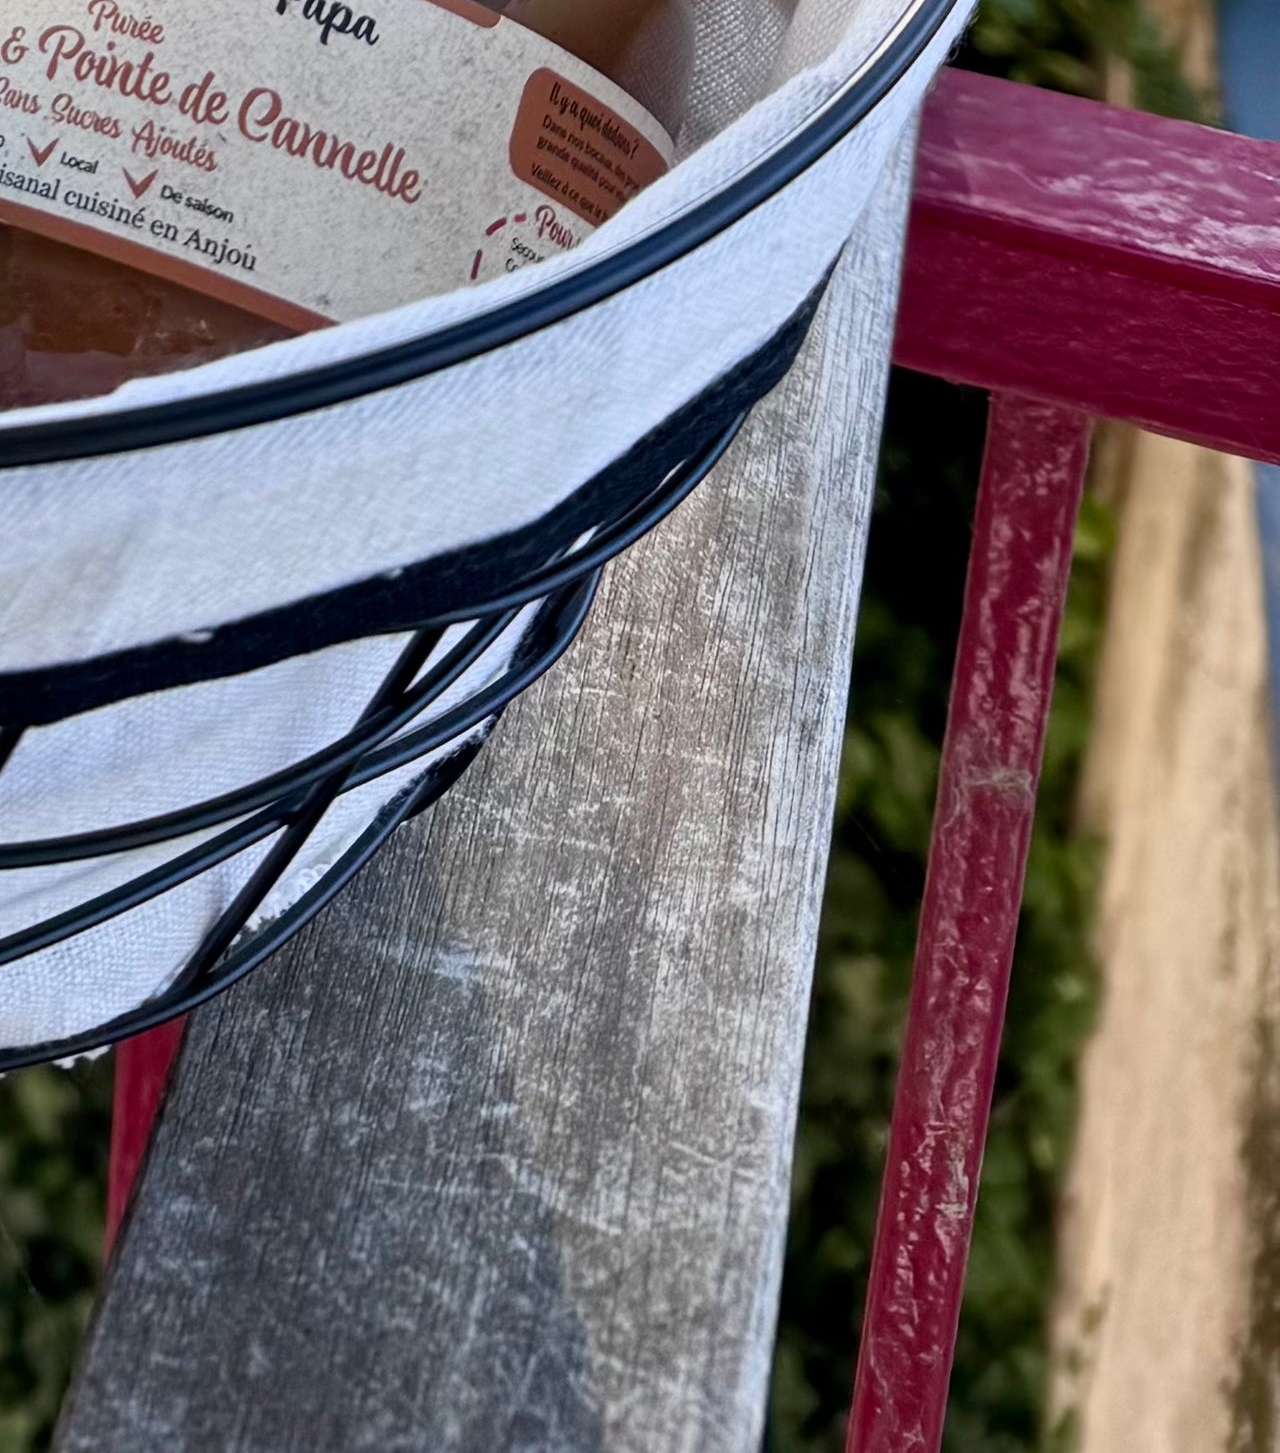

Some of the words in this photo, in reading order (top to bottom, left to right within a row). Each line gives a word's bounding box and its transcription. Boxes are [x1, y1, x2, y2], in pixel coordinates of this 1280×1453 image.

[1, 26, 30, 64] &
[39, 24, 173, 107] Pointe
[178, 71, 231, 125] de
[238, 87, 422, 204] Cannelle
[50, 92, 123, 140] Sucres
[131, 120, 219, 173] Ajoutés
[60, 150, 100, 175] Local
[160, 183, 182, 203] De
[183, 193, 236, 225] saison
[63, 187, 146, 232] cuisiné
[149, 215, 180, 243] en
[184, 227, 259, 274] Anjou
